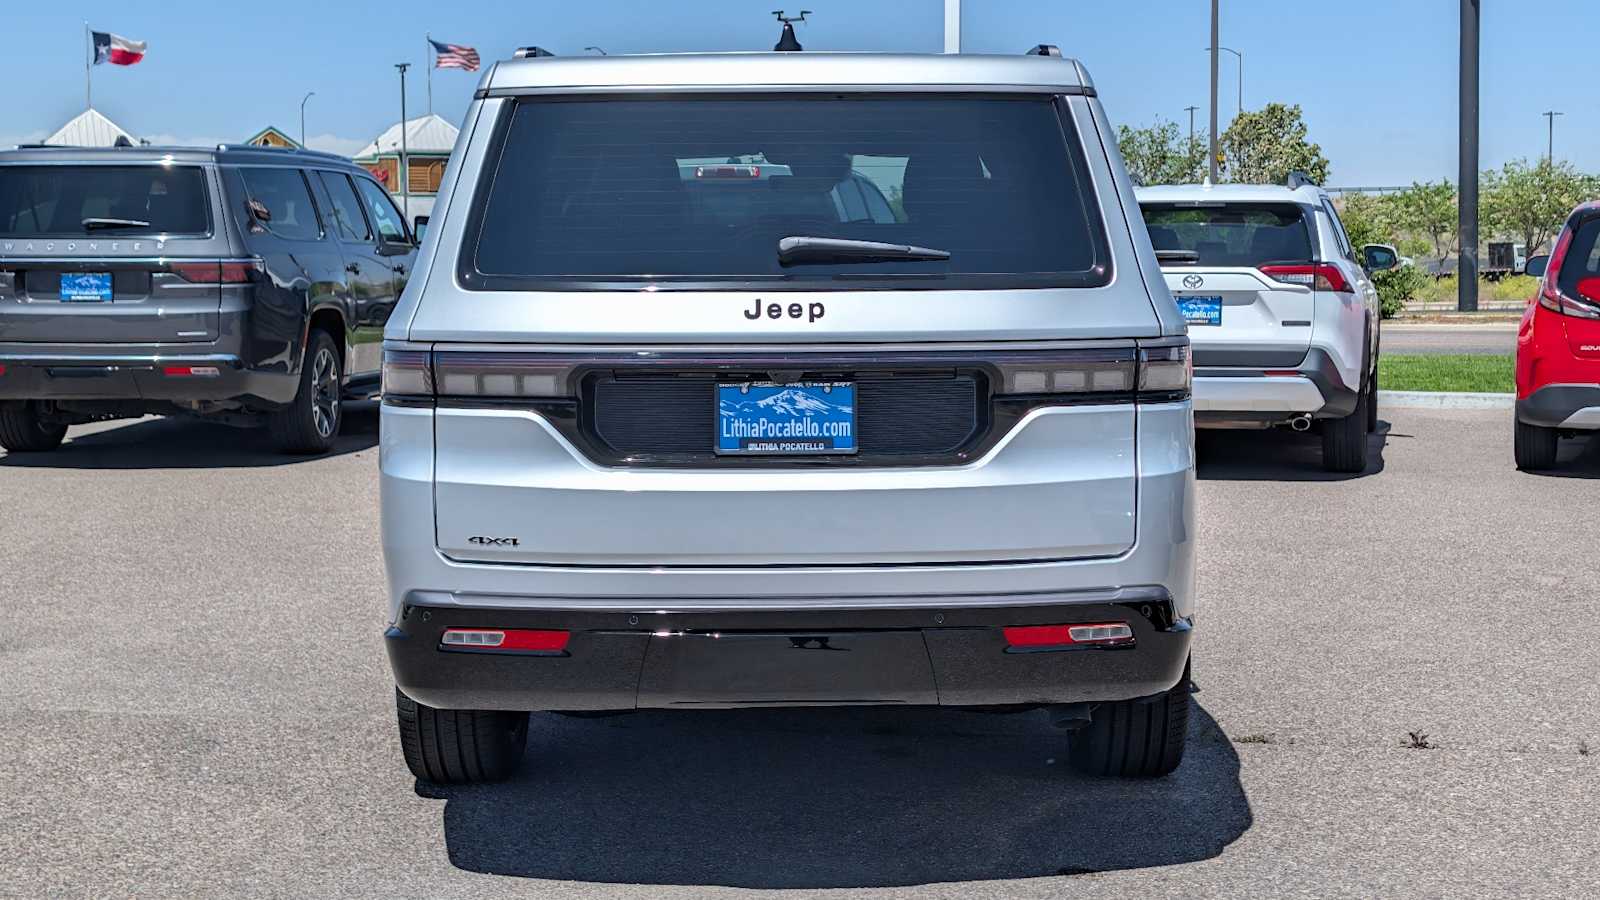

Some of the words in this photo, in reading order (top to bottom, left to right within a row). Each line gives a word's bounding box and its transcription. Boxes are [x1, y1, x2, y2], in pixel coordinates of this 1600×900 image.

[744, 298, 825, 322] Jeep
[722, 417, 851, 438] LithiaPocatello.com
[780, 442, 825, 451] POCATELLO
